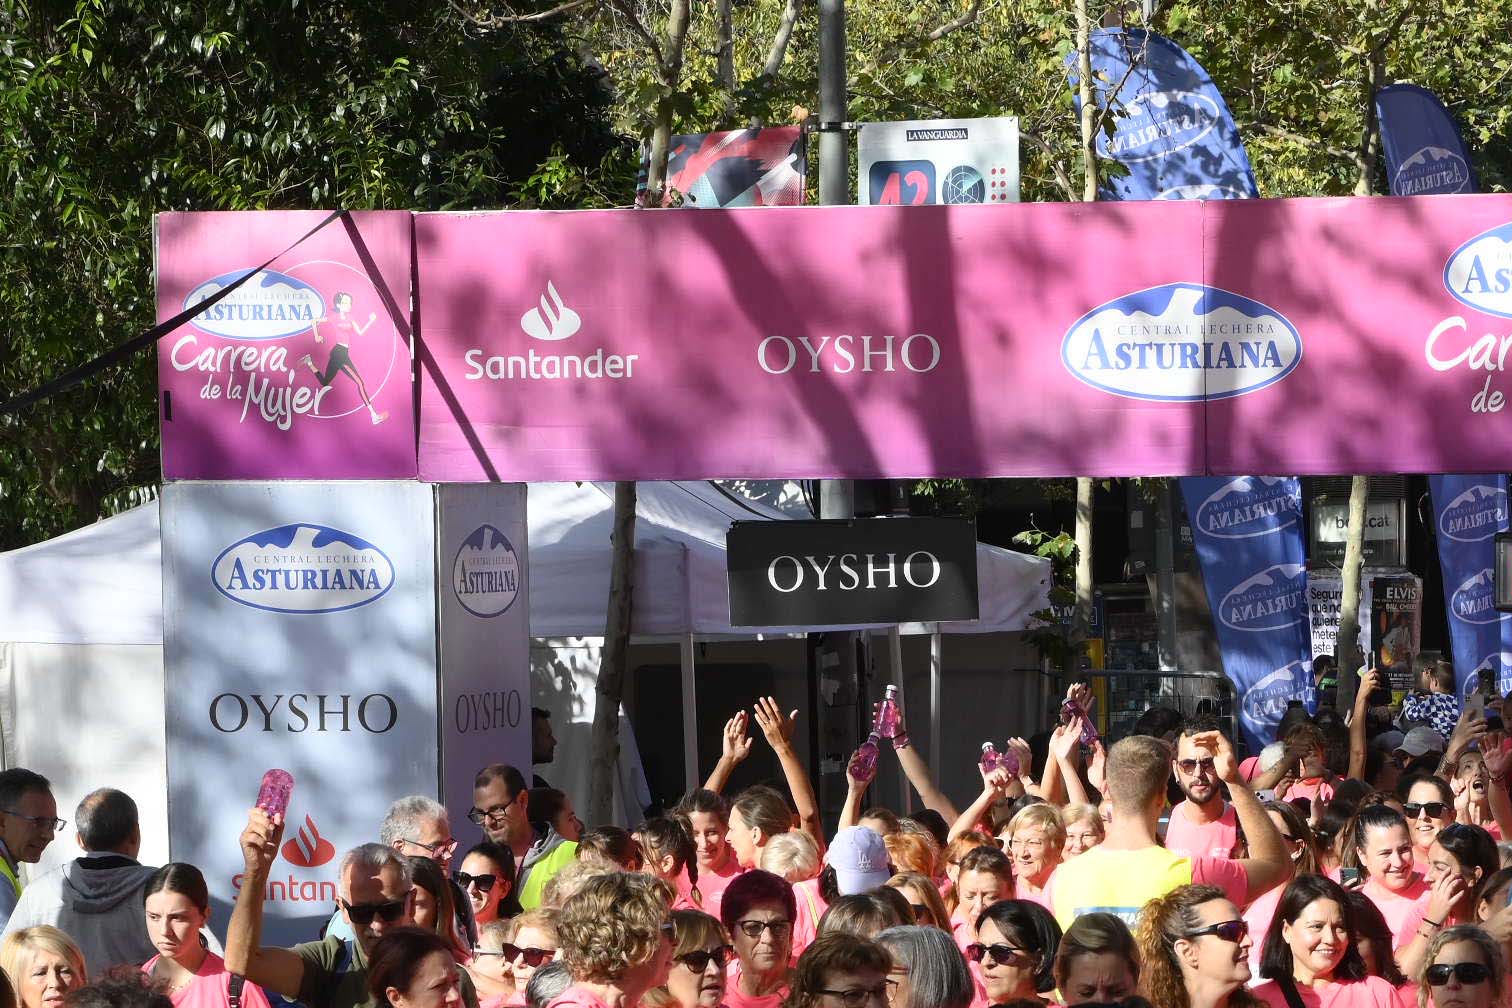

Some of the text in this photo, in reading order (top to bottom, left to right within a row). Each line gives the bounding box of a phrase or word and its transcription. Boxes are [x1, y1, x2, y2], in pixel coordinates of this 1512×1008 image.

[908, 129, 967, 140] LA VANGUARDIA
[194, 294, 316, 321] ASTURIANA
[1117, 323, 1275, 336] CENTRAL LECHERA
[170, 335, 288, 372] Carrera
[464, 348, 639, 381] Santander
[757, 333, 942, 375] OYSHO
[1081, 328, 1284, 369] ASTURIANA
[200, 369, 333, 431] de la Mujer
[1471, 374, 1506, 413] de
[1336, 514, 1389, 529] b.cat
[226, 556, 382, 591] ASTURIANA
[254, 554, 376, 564] CENTRAL LECHERA
[767, 551, 941, 592] OYSHO
[459, 559, 516, 595] ASTURIANA
[1386, 586, 1417, 600] ELVIS
[1311, 587, 1343, 602] Segur
[1311, 604, 1327, 614] que
[1312, 617, 1344, 628] quiere
[1313, 642, 1332, 654] este
[209, 693, 398, 733] OYSHO
[455, 689, 521, 734] OYSHO
